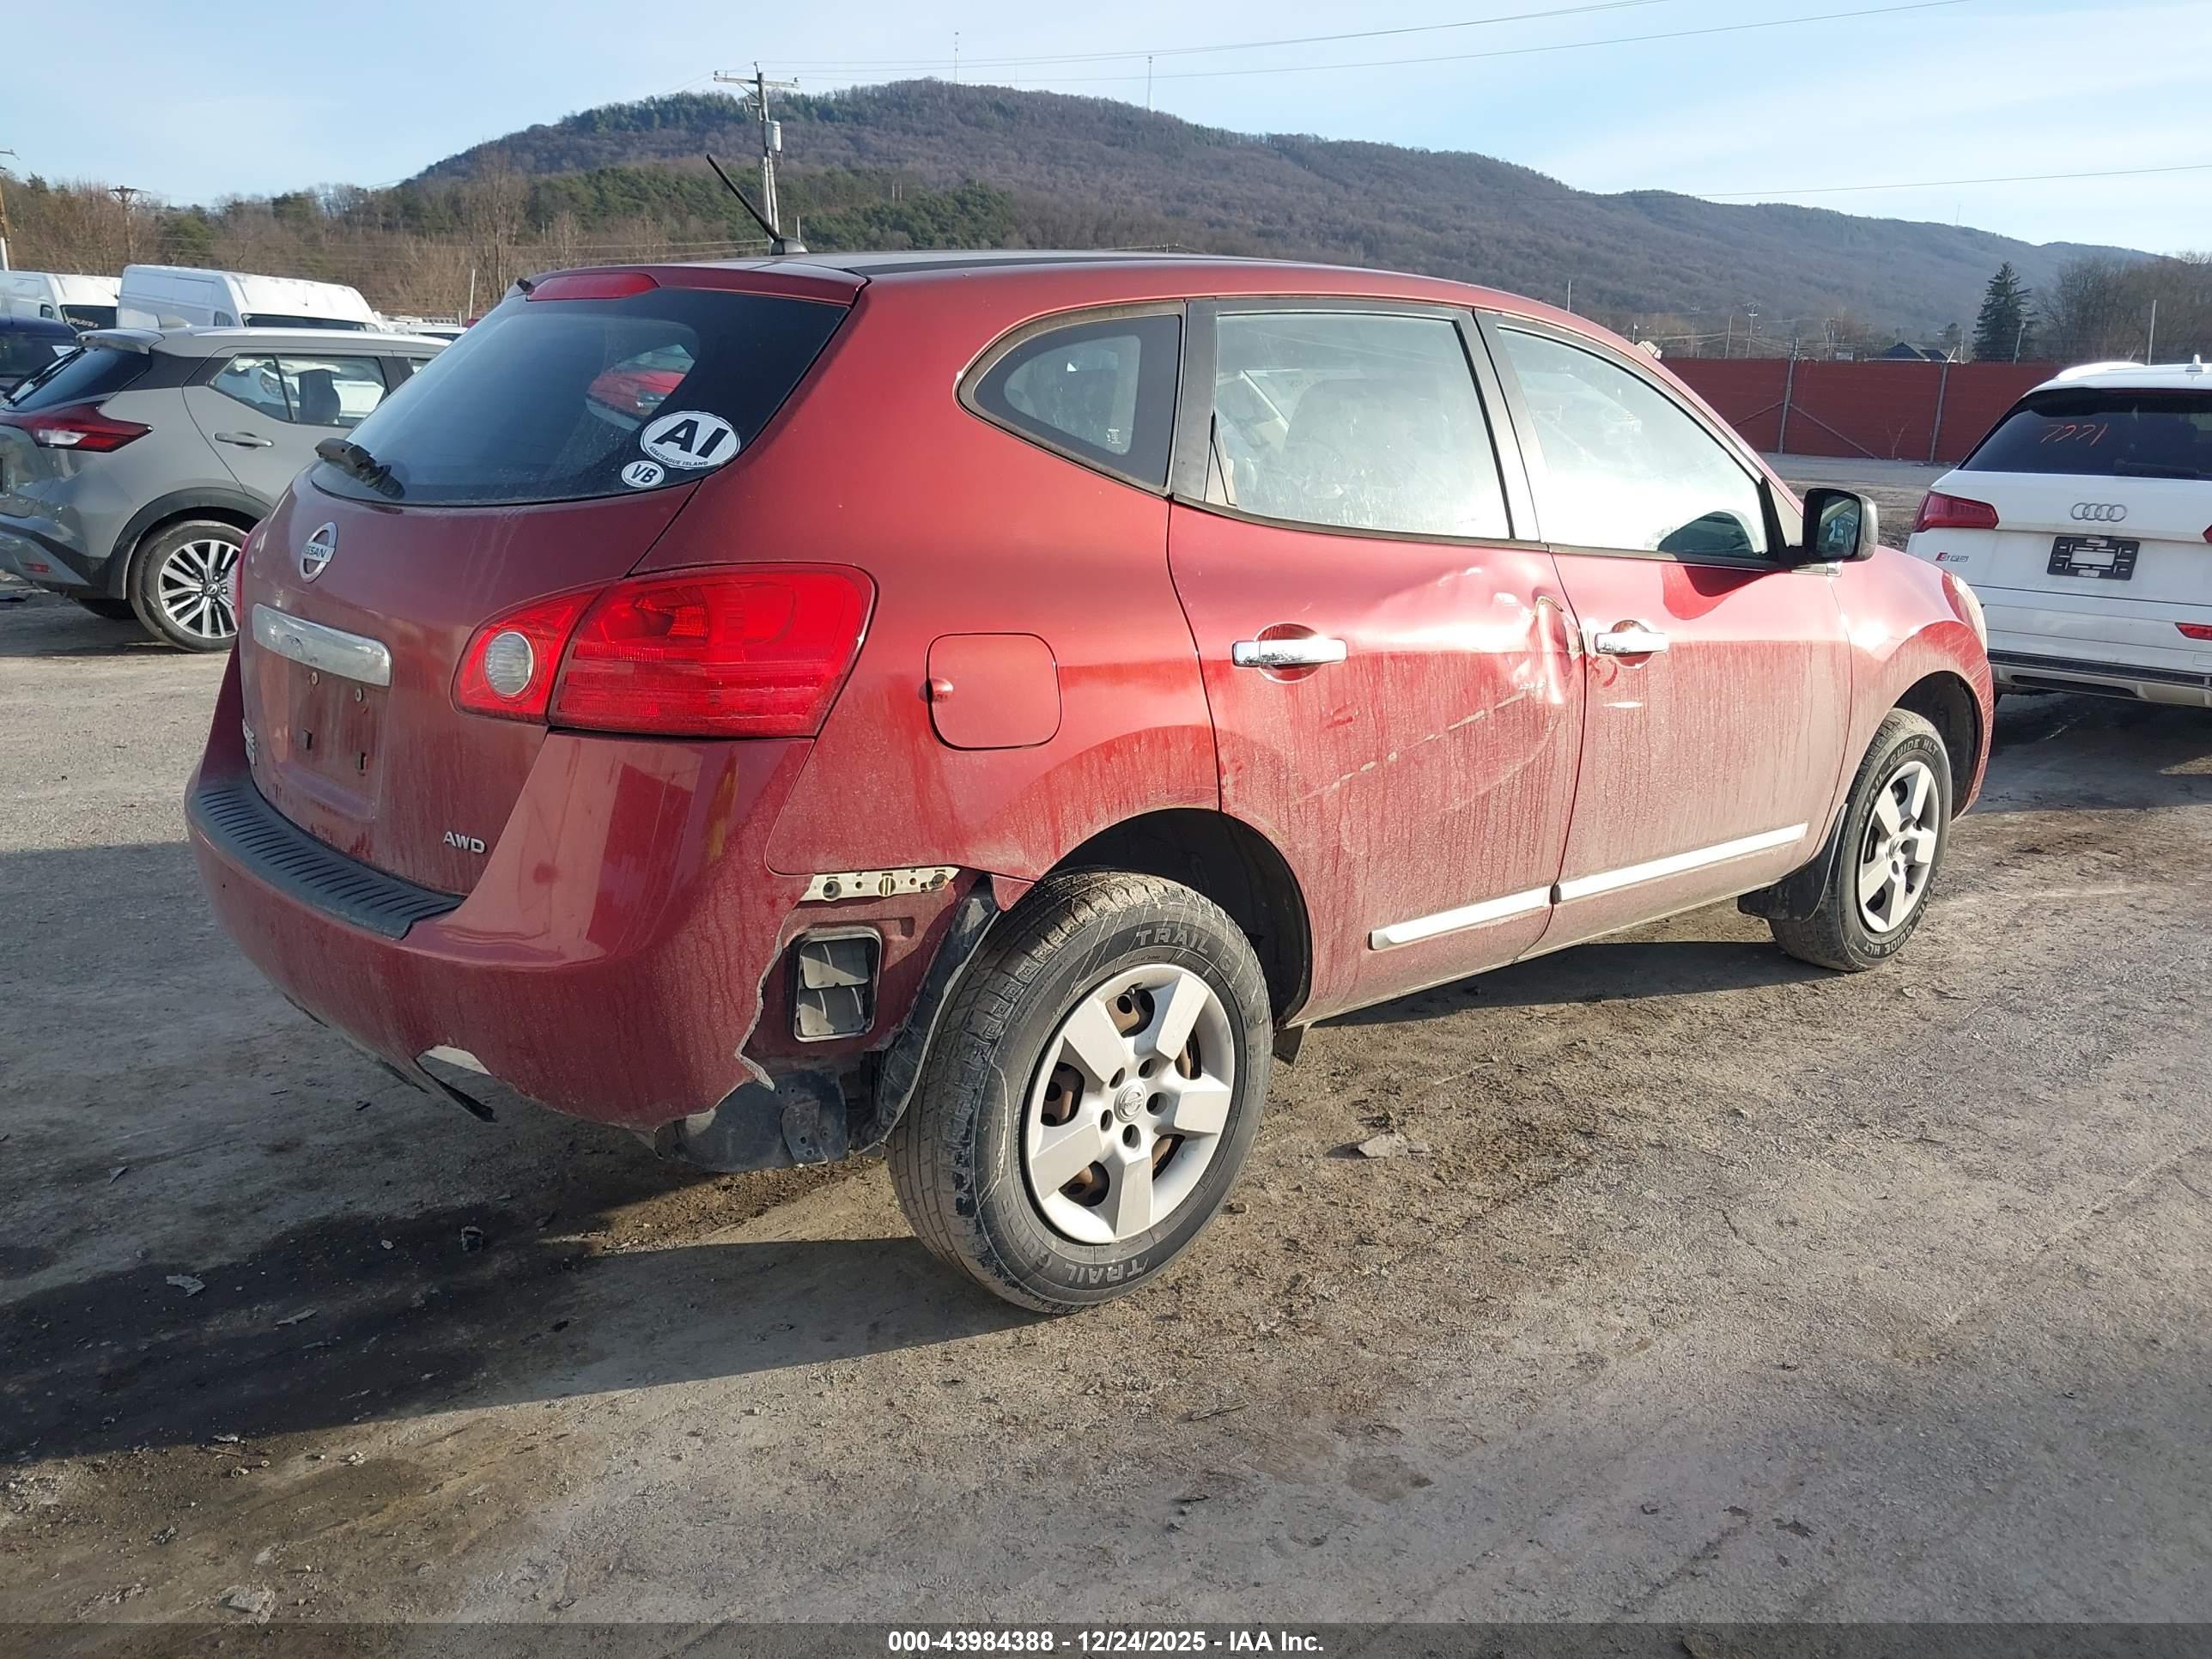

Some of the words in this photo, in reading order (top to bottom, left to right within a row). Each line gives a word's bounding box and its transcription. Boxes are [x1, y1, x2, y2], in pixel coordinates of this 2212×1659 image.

[652, 418, 729, 459] AI
[631, 464, 658, 483] VB
[1890, 738, 1920, 765] GUIDE
[1923, 738, 1939, 756] HLT
[443, 830, 485, 854] AWD
[1136, 927, 1210, 956] TRAIL
[1863, 941, 1881, 956] HLT
[1885, 924, 1912, 955] GUIDE
[1064, 1258, 1144, 1285] TRAIL
